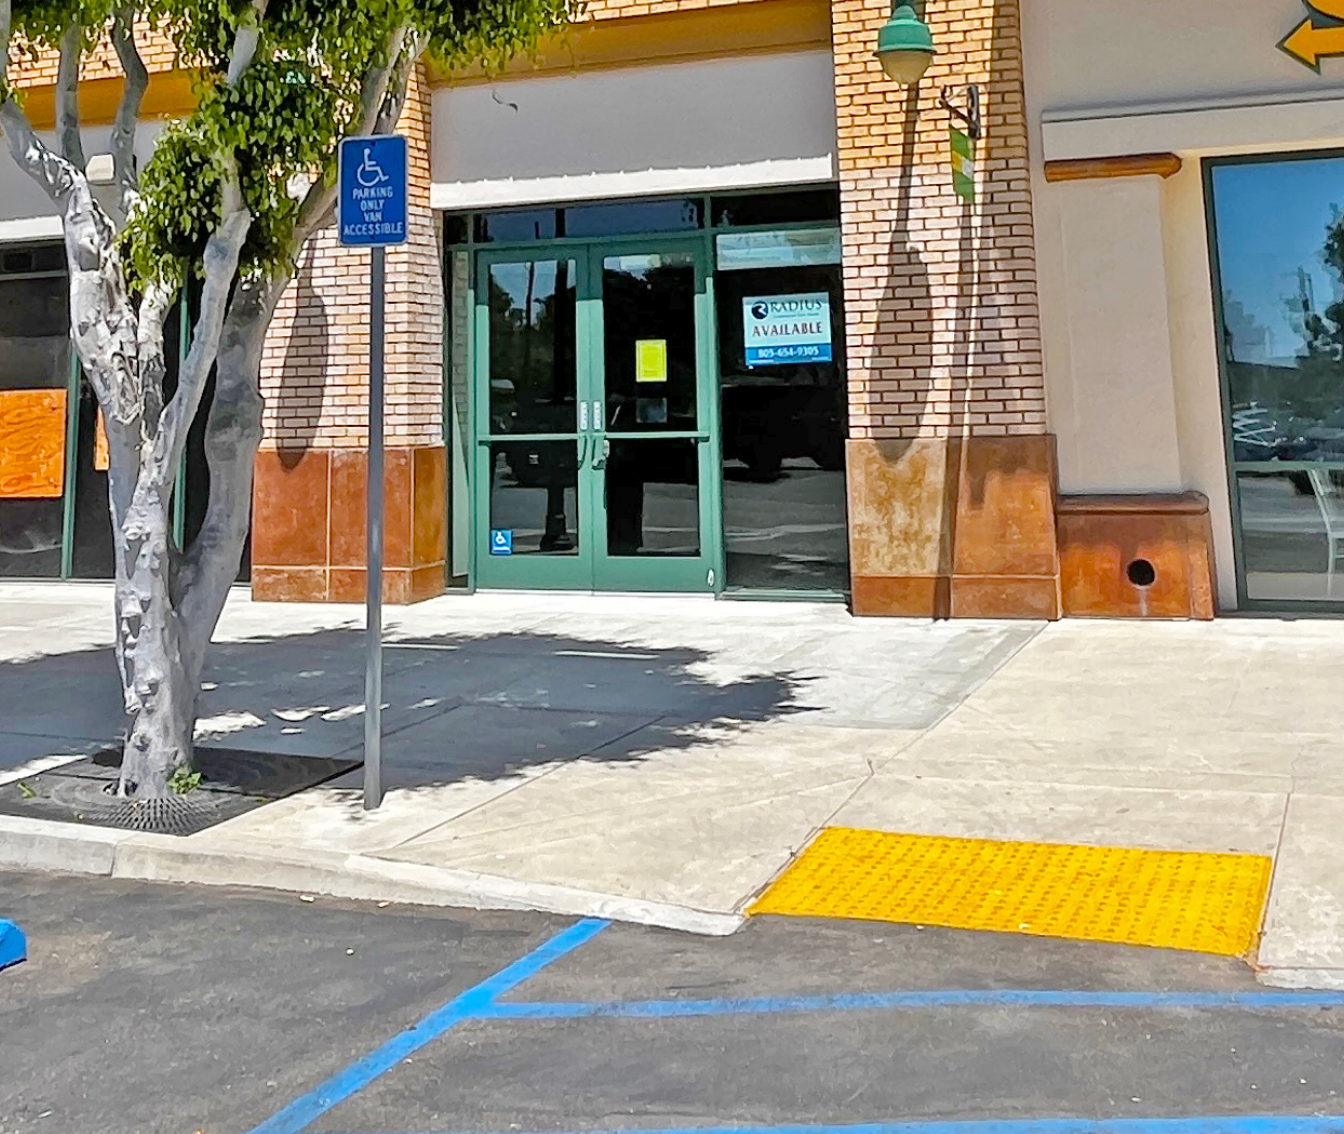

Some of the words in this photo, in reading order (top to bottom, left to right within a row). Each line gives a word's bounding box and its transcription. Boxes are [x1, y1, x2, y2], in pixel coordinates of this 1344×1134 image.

[352, 186, 393, 200] PARKING
[360, 199, 385, 211] ONLY
[364, 211, 383, 222] VAN
[343, 222, 404, 236] ACCESSIBLE
[770, 299, 823, 313] RADIUS
[752, 322, 824, 337] AVAILABLE
